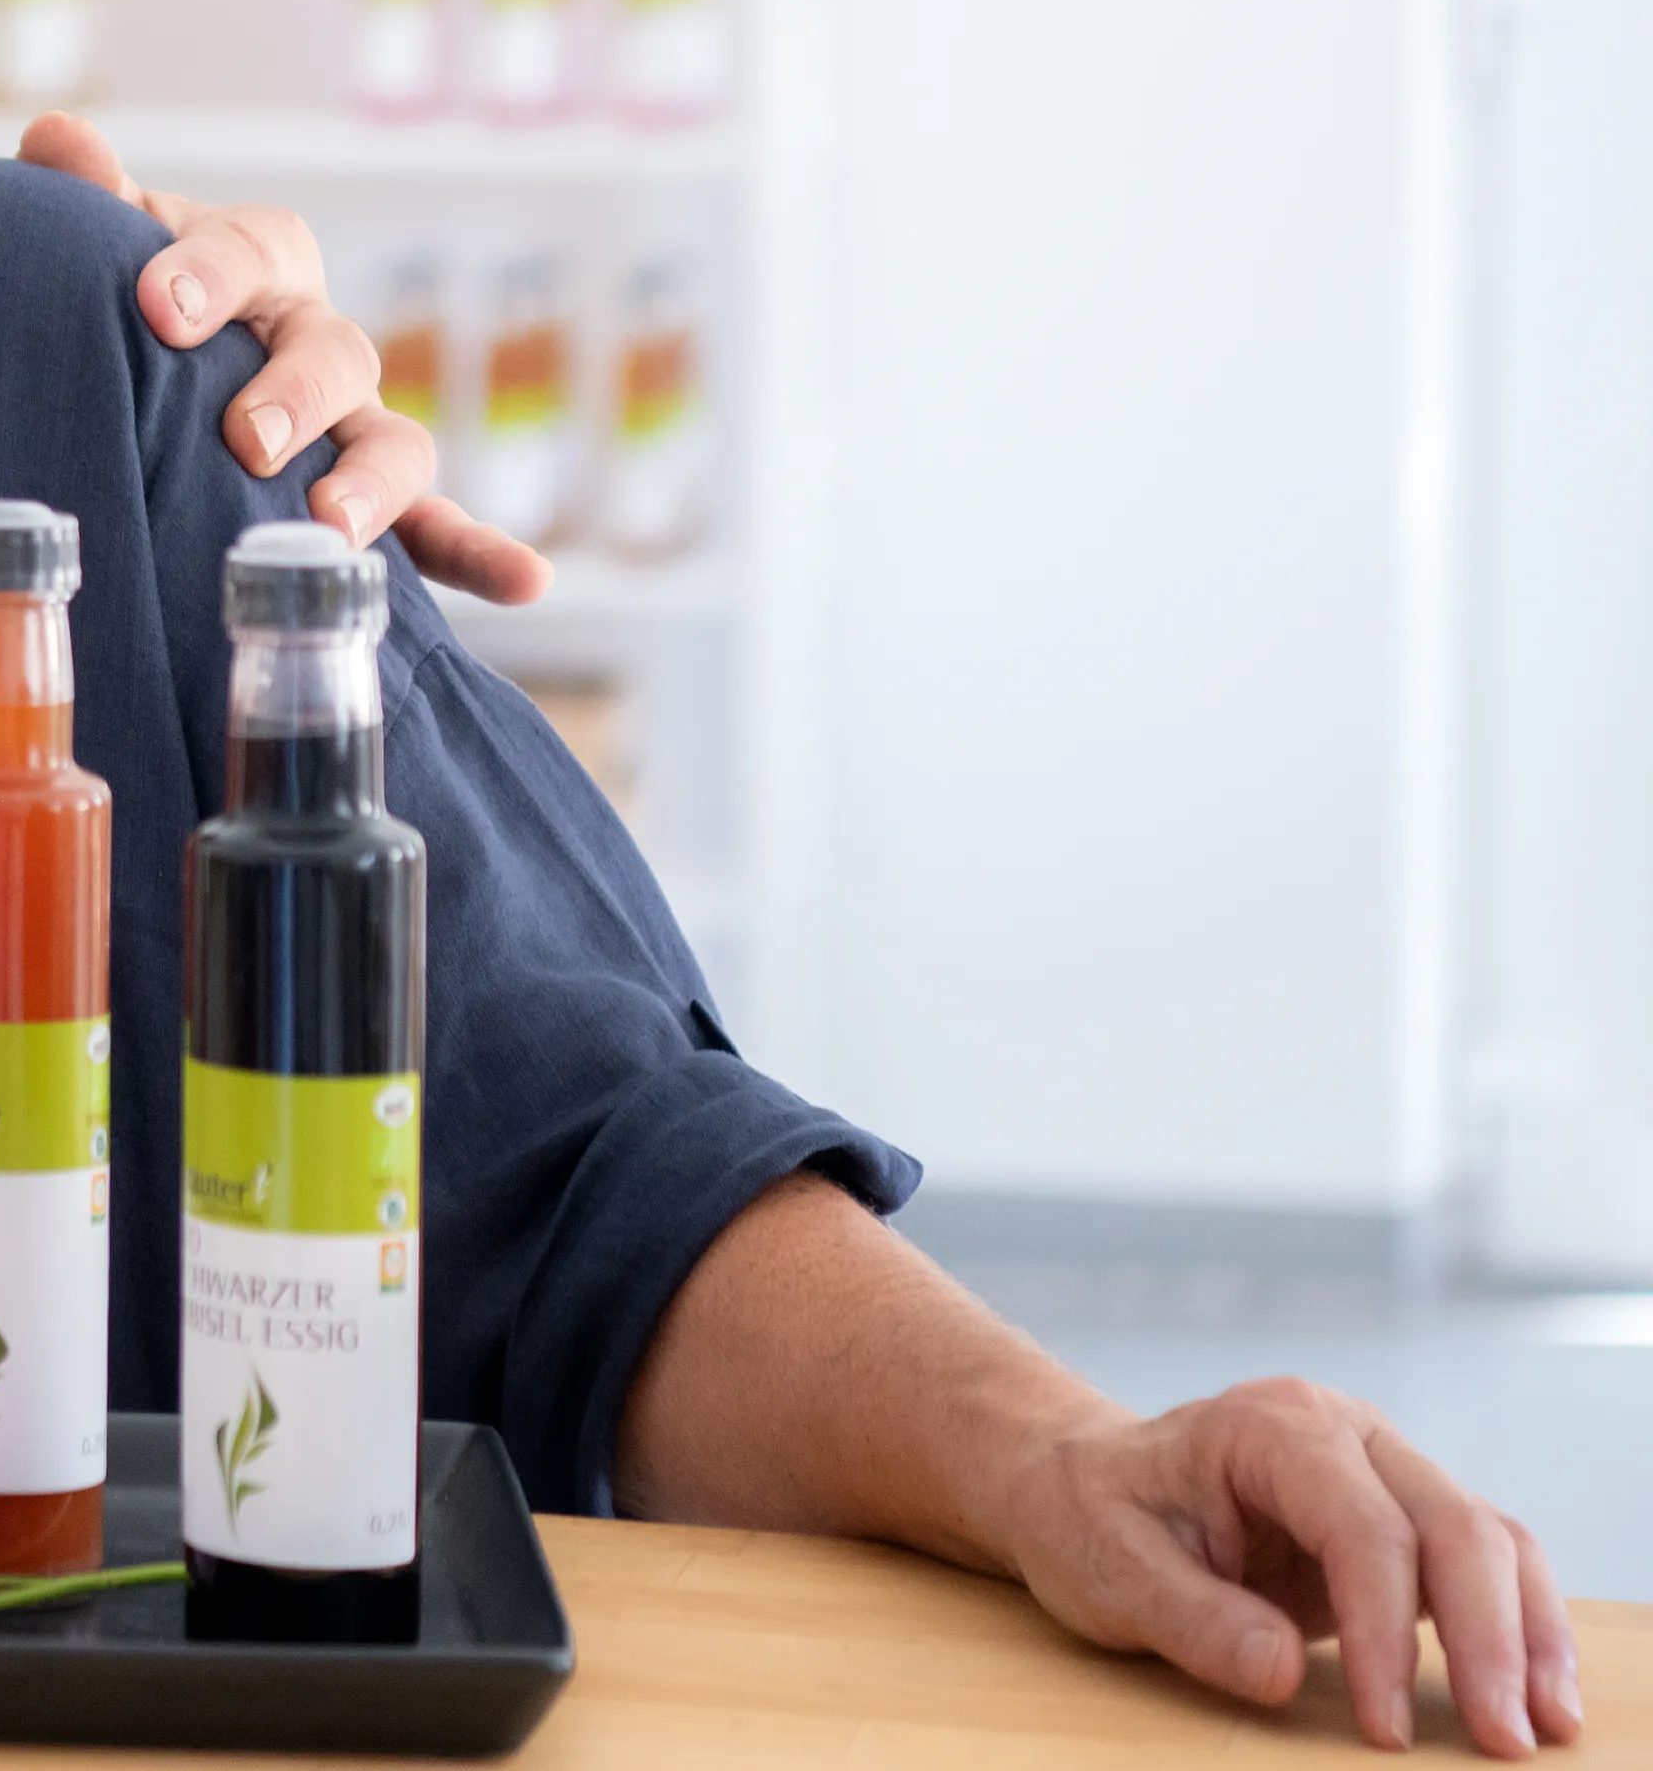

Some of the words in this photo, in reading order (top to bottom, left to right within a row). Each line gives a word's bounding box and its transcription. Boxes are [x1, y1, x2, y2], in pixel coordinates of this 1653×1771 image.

[189, 1169, 249, 1204] äuter
[190, 1263, 335, 1312] HWARZER
[189, 1298, 252, 1345] BISEL
[265, 1315, 360, 1354] ESSIG
